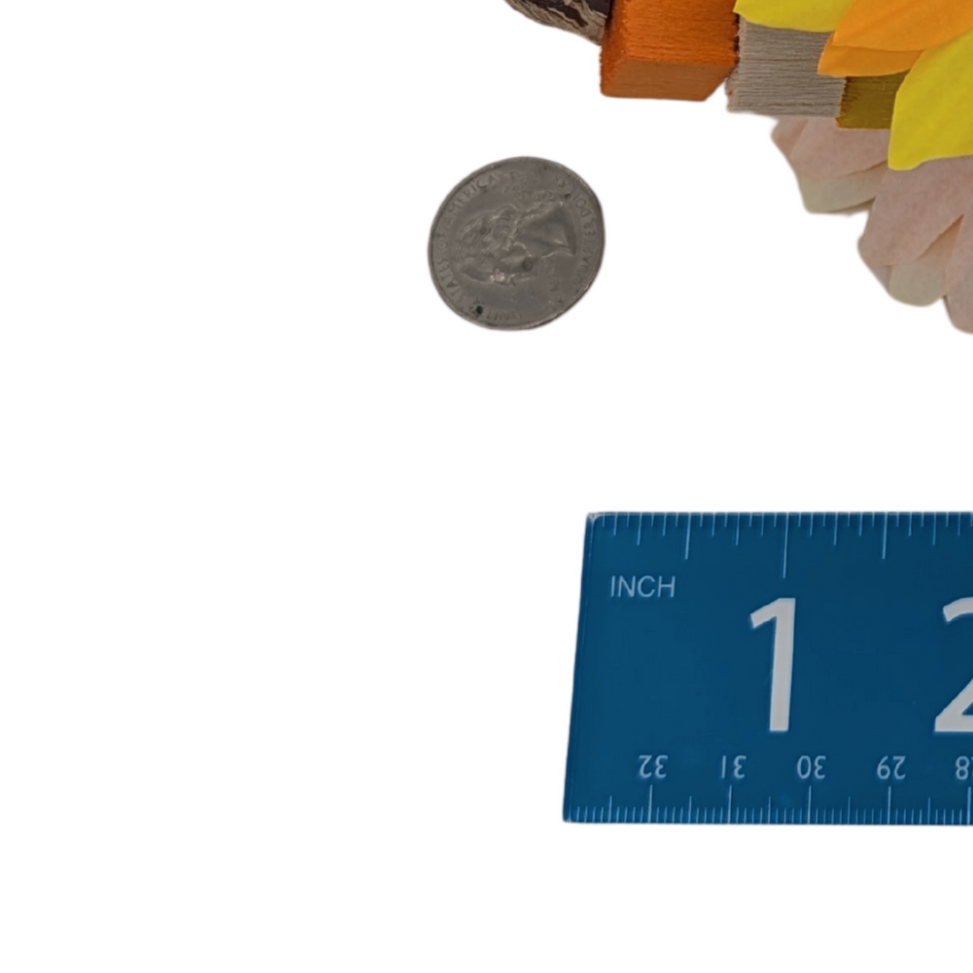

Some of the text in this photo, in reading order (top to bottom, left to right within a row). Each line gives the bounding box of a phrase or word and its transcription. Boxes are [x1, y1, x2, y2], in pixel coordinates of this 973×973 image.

[610, 575, 677, 598] INCH
[750, 597, 796, 732] 1
[639, 755, 668, 779] 32
[721, 755, 747, 779] 31
[796, 755, 826, 780] 30
[876, 756, 906, 780] 29
